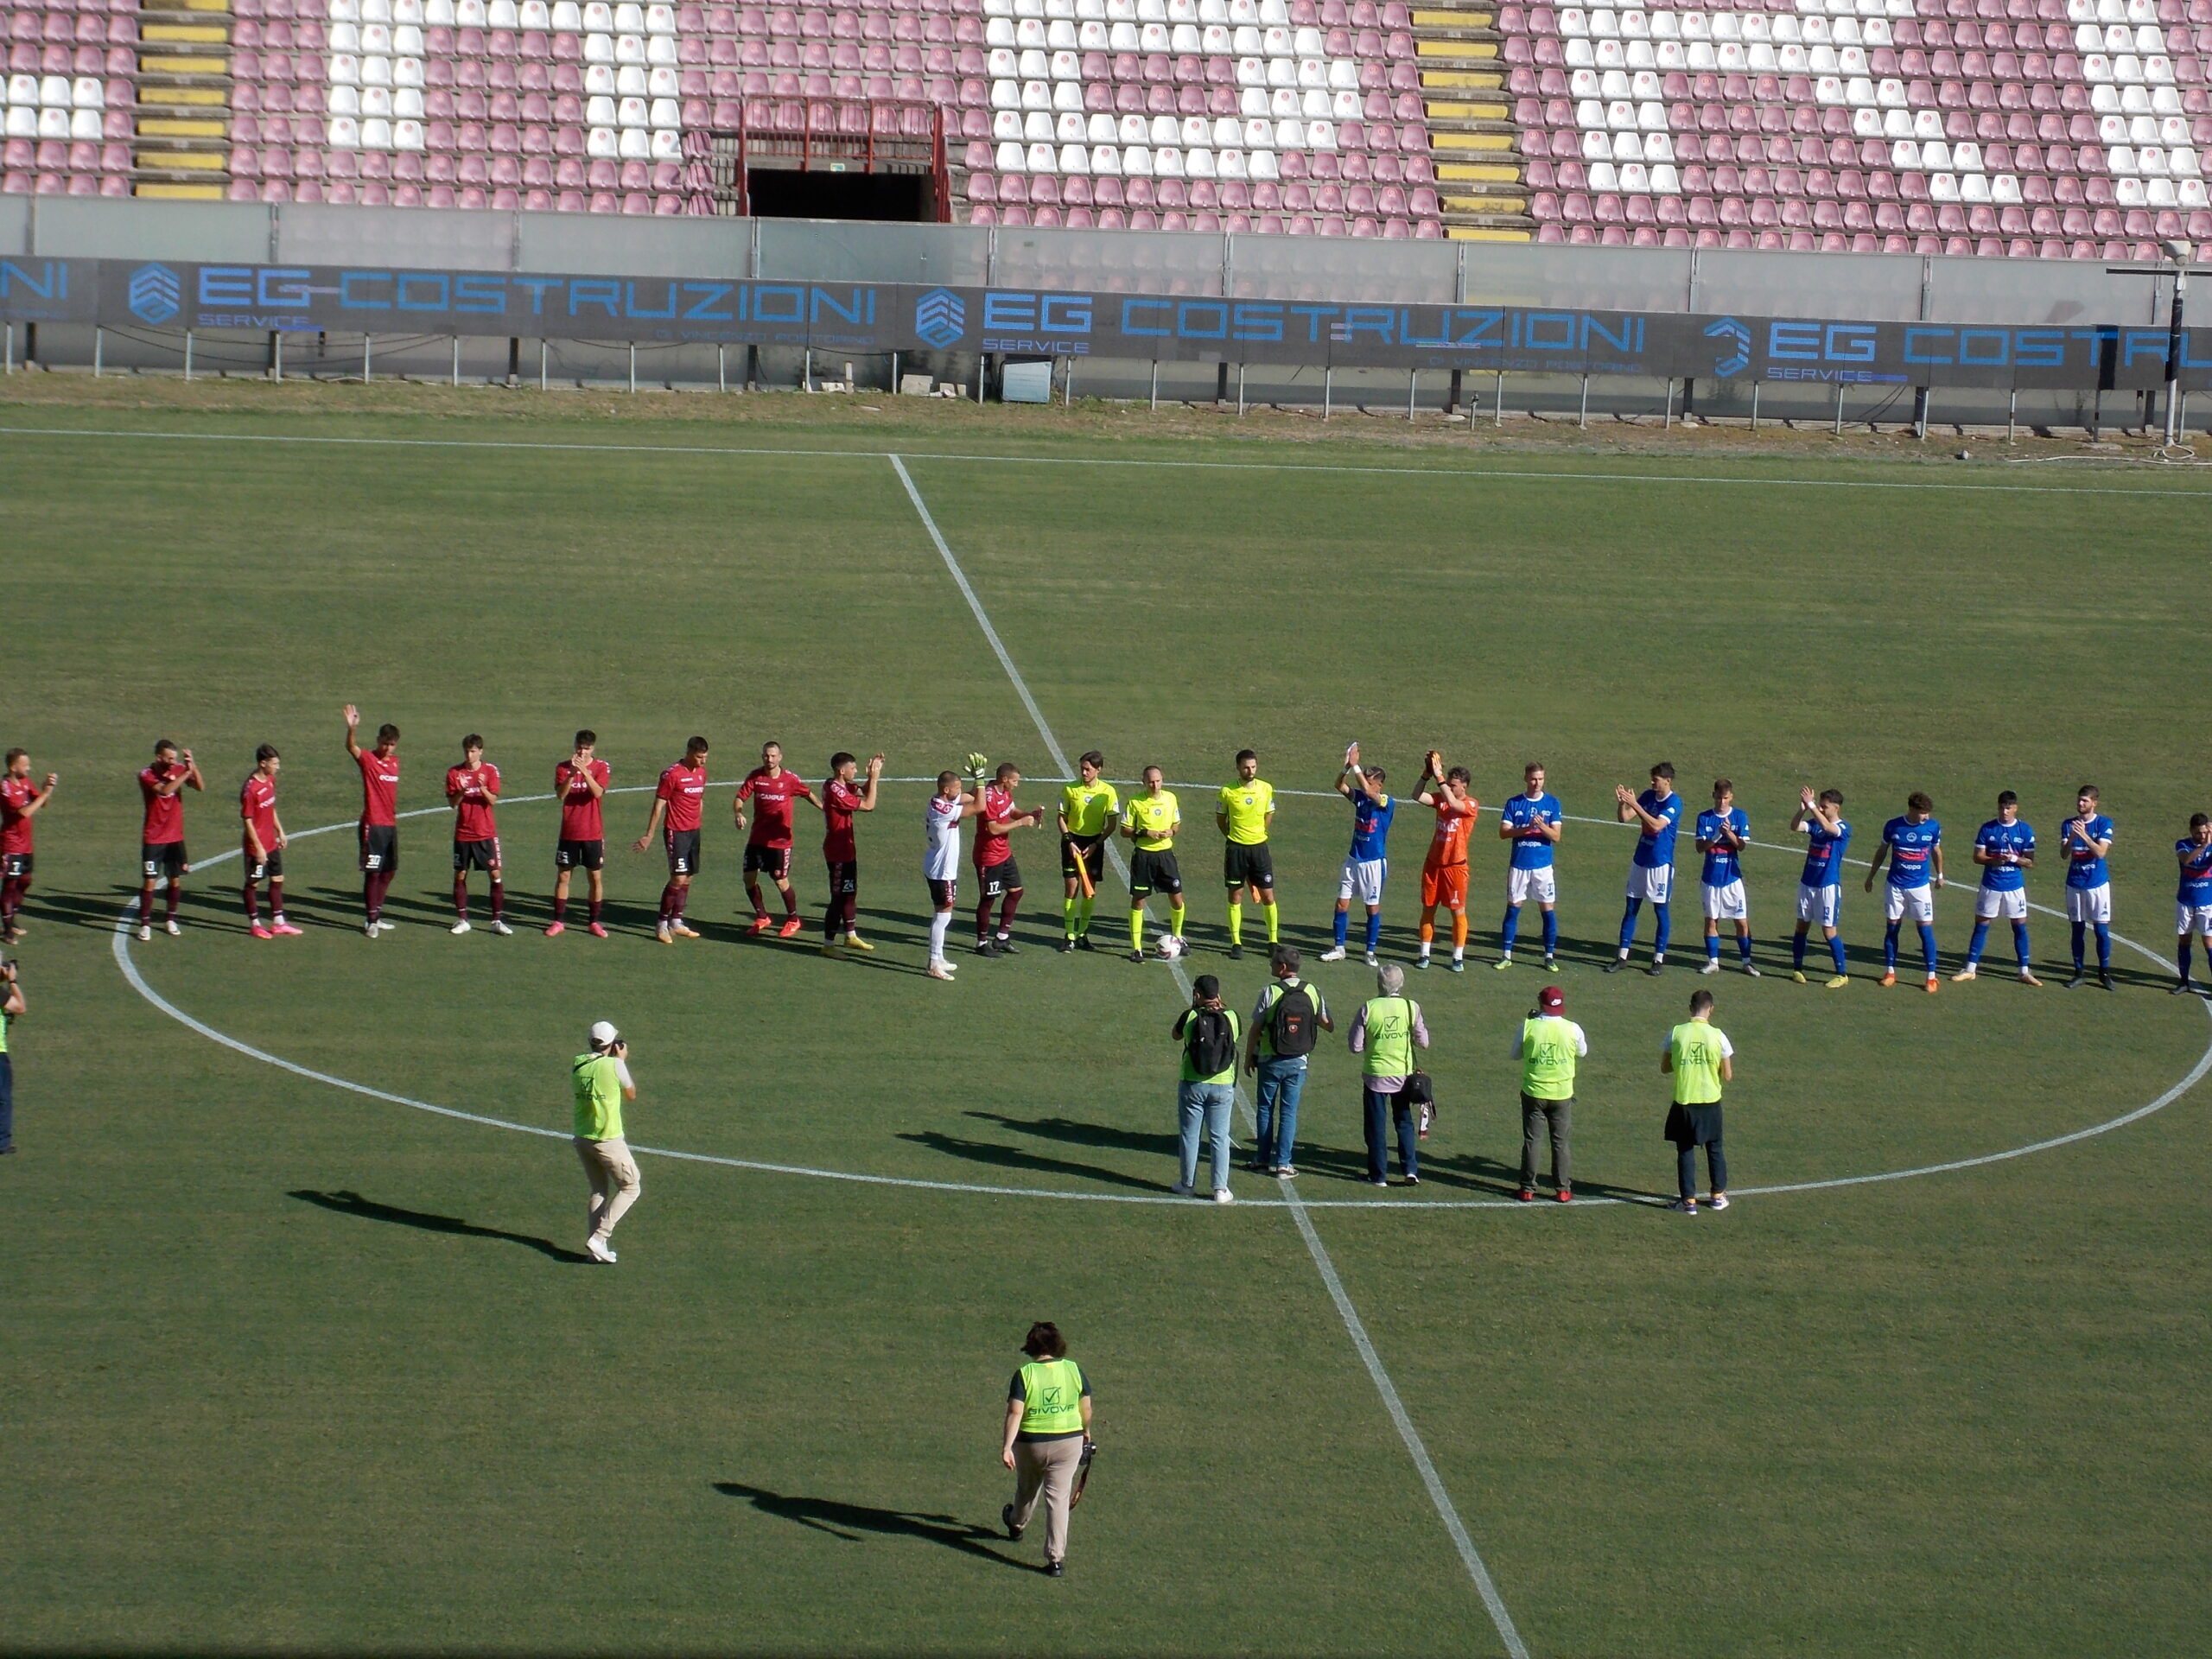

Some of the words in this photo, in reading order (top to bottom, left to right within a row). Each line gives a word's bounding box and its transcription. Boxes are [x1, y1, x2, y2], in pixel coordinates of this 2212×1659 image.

[199, 266, 312, 308] EG
[340, 270, 876, 325] COSTRUZIONI
[198, 314, 311, 328] SERVICE
[983, 293, 1093, 333] EG
[1122, 298, 1645, 353] COSTRUZIONI
[982, 338, 1090, 354] SERVICE
[1769, 321, 1877, 362] EG
[1767, 367, 1873, 382] SERVICE
[368, 855, 382, 865] 30
[678, 858, 685, 868] 5
[14, 861, 21, 872] 7
[843, 880, 854, 889] 24
[989, 881, 1000, 892] 17
[1656, 883, 1665, 892] 30
[1372, 887, 1377, 895] 3
[1028, 1404, 1075, 1415] GIVOVA
